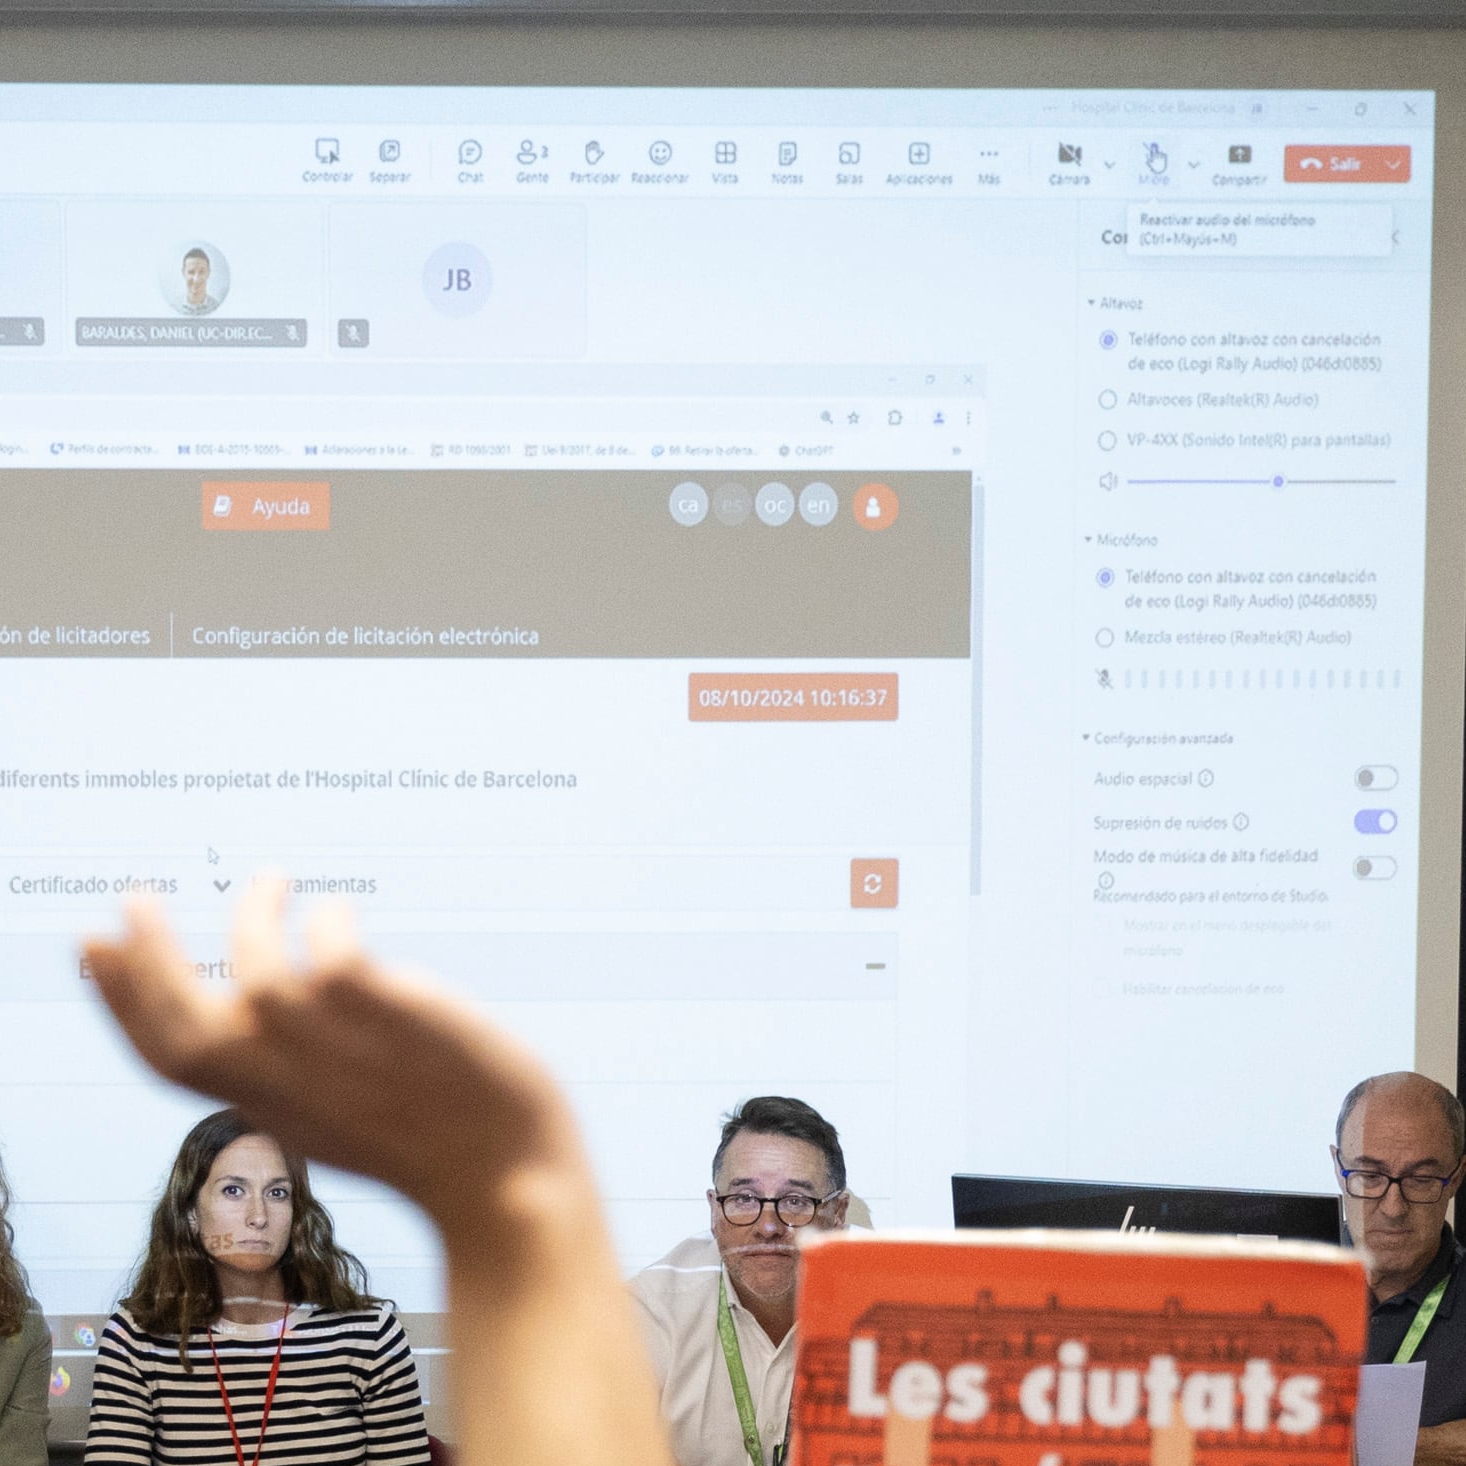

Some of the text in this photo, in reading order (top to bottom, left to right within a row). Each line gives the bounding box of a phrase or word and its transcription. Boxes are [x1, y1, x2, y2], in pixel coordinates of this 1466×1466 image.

[1329, 155, 1363, 172] Salir
[369, 171, 411, 184] Separar
[457, 170, 484, 183] Chat
[516, 171, 549, 184] Gente
[569, 171, 621, 184] Participar
[631, 171, 690, 184] Reaccionar
[710, 171, 740, 184] Vista
[771, 173, 804, 185] Notas
[835, 173, 864, 185] Salas
[885, 173, 954, 187] Aplicaciones
[977, 170, 1002, 186] Más
[1212, 173, 1269, 188] Compartir
[1139, 213, 1317, 227] Reactivar audio del micrófono
[441, 267, 473, 292] JB
[1099, 297, 1145, 311] Altavoz
[150, 325, 195, 341] DANIEL
[1128, 331, 1382, 347] Teléfono con altavoz con cancelación
[1126, 391, 1320, 409] Altavoces (Realtek(R) Audio)
[1182, 432, 1235, 450] (Sonido
[1291, 432, 1323, 450] para
[1325, 432, 1393, 450] pantallas)
[252, 497, 311, 520] Ayuda
[678, 499, 699, 514] ca
[764, 499, 787, 514] oc
[806, 499, 831, 514] en
[1096, 532, 1160, 548] Micrófono
[1125, 568, 1378, 584] Teléfono con altavoz con cancelación
[29, 626, 51, 645] de
[55, 626, 151, 646] licitadores
[193, 626, 541, 650] Configuración de licitación electrónica
[1125, 629, 1352, 646] Mezcla estéreo (Realtek(R) Audio)
[699, 688, 888, 708] 08/10/2024 10:16:37
[1094, 732, 1235, 749] Configuración avanzada
[84, 769, 178, 789] immobles
[183, 770, 271, 793] propietat
[276, 769, 300, 789] de
[305, 768, 393, 793] l'Hospital
[397, 769, 449, 790] Clínic
[454, 769, 478, 790] de
[483, 770, 578, 790] Barcelona
[1094, 771, 1193, 788] Audio espacial
[1093, 815, 1228, 831] Supresión de ruidos
[1093, 849, 1319, 864] Modo de música de alta fidelidad
[9, 874, 179, 895] Certificado ofertas
[848, 1336, 1324, 1435] Les ciutats
